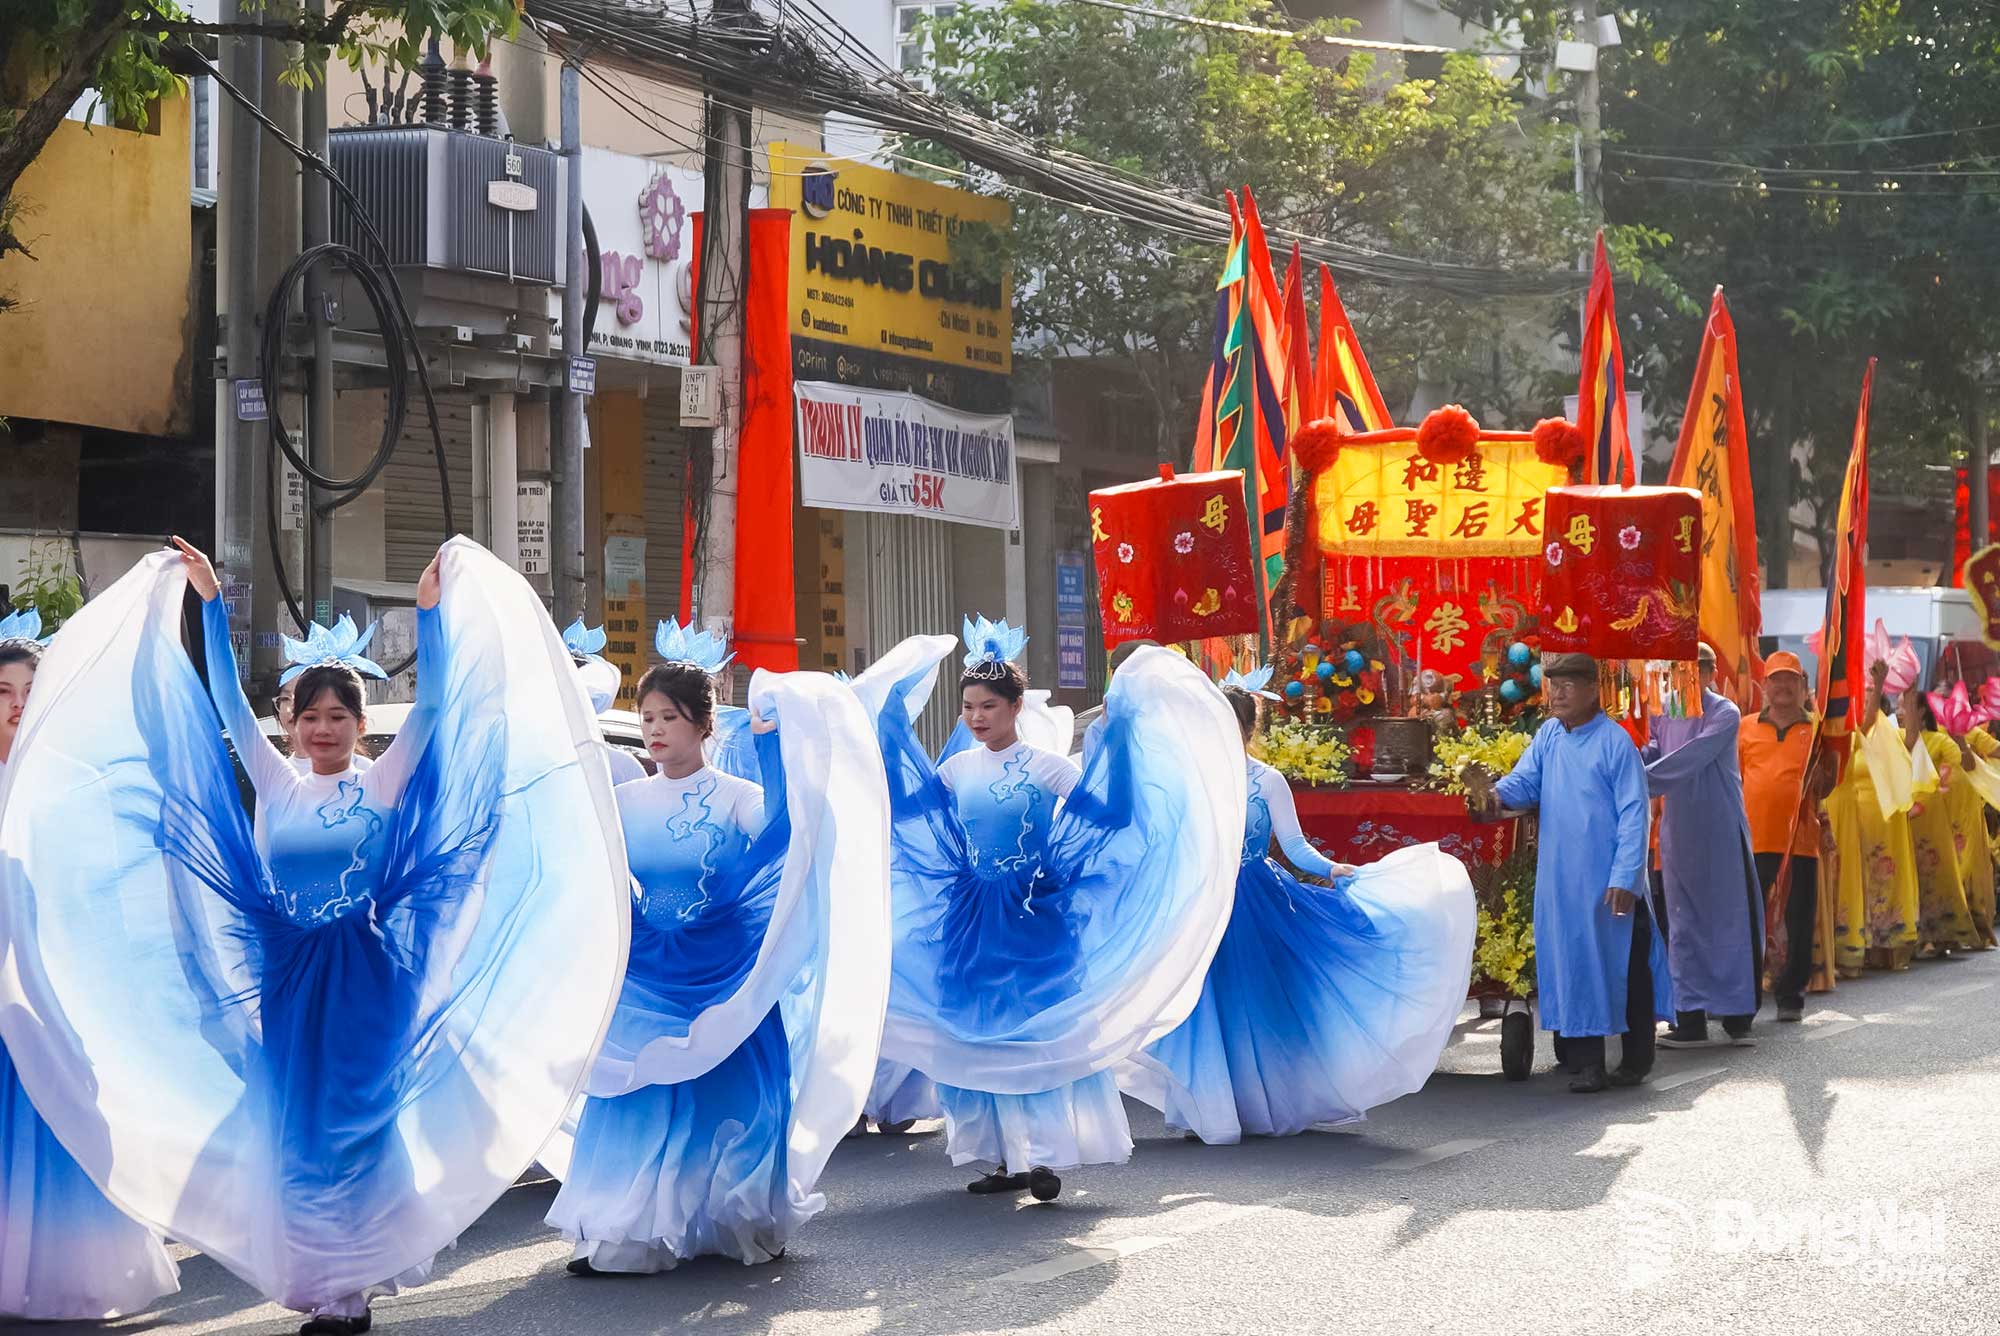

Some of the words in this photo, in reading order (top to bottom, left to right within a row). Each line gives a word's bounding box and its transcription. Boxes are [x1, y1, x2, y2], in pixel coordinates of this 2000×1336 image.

[507, 158, 520, 173] 560
[837, 187, 866, 216] CÔNG
[868, 197, 883, 220] TY
[885, 201, 913, 228] TNHH
[916, 208, 944, 235] THIẾT
[685, 372, 706, 383] VNPT
[688, 404, 698, 414] 50
[864, 402, 894, 469] QUẦN
[880, 477, 899, 504] GIÁ
[525, 561, 537, 573] 01
